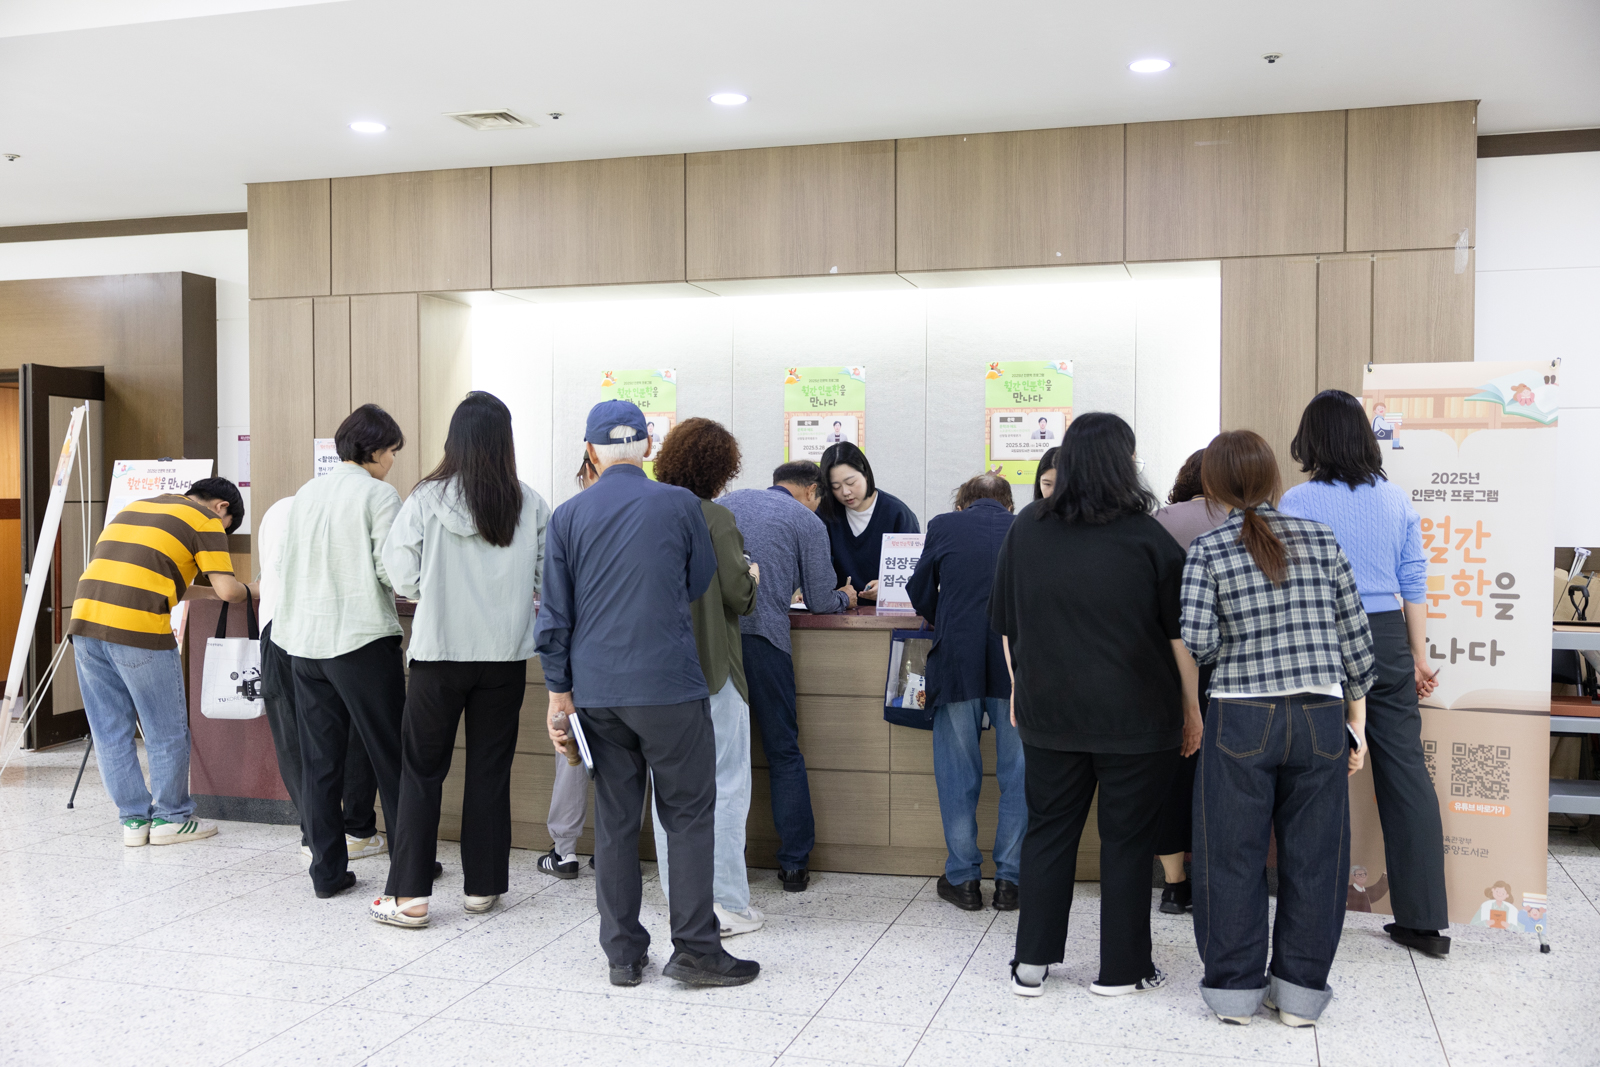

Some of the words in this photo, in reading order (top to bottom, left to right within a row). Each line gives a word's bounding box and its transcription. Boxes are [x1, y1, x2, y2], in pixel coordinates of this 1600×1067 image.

[616, 386, 632, 399] 월간
[632, 386, 659, 398] 인문학을
[801, 384, 818, 397] 월간
[817, 384, 847, 397] 인문학을
[1003, 379, 1021, 392] 월간
[1021, 379, 1053, 392] 인문학을
[809, 396, 838, 408] 만나다
[1012, 391, 1043, 404] 만나다
[127, 476, 141, 491] 월간
[141, 476, 166, 491] 인문학을
[168, 476, 194, 490] 만나다
[1430, 471, 1480, 485] 2025년
[1411, 489, 1448, 503] 인문학
[1450, 489, 1499, 503] 프로그램
[1420, 515, 1492, 564] 월간
[885, 556, 920, 571] 현장등
[1425, 568, 1521, 621] 문학을
[1425, 636, 1506, 667] 나다
[1454, 802, 1476, 812] 유튜브
[1476, 804, 1506, 816] 바로가기
[1443, 835, 1472, 845] 육관광부
